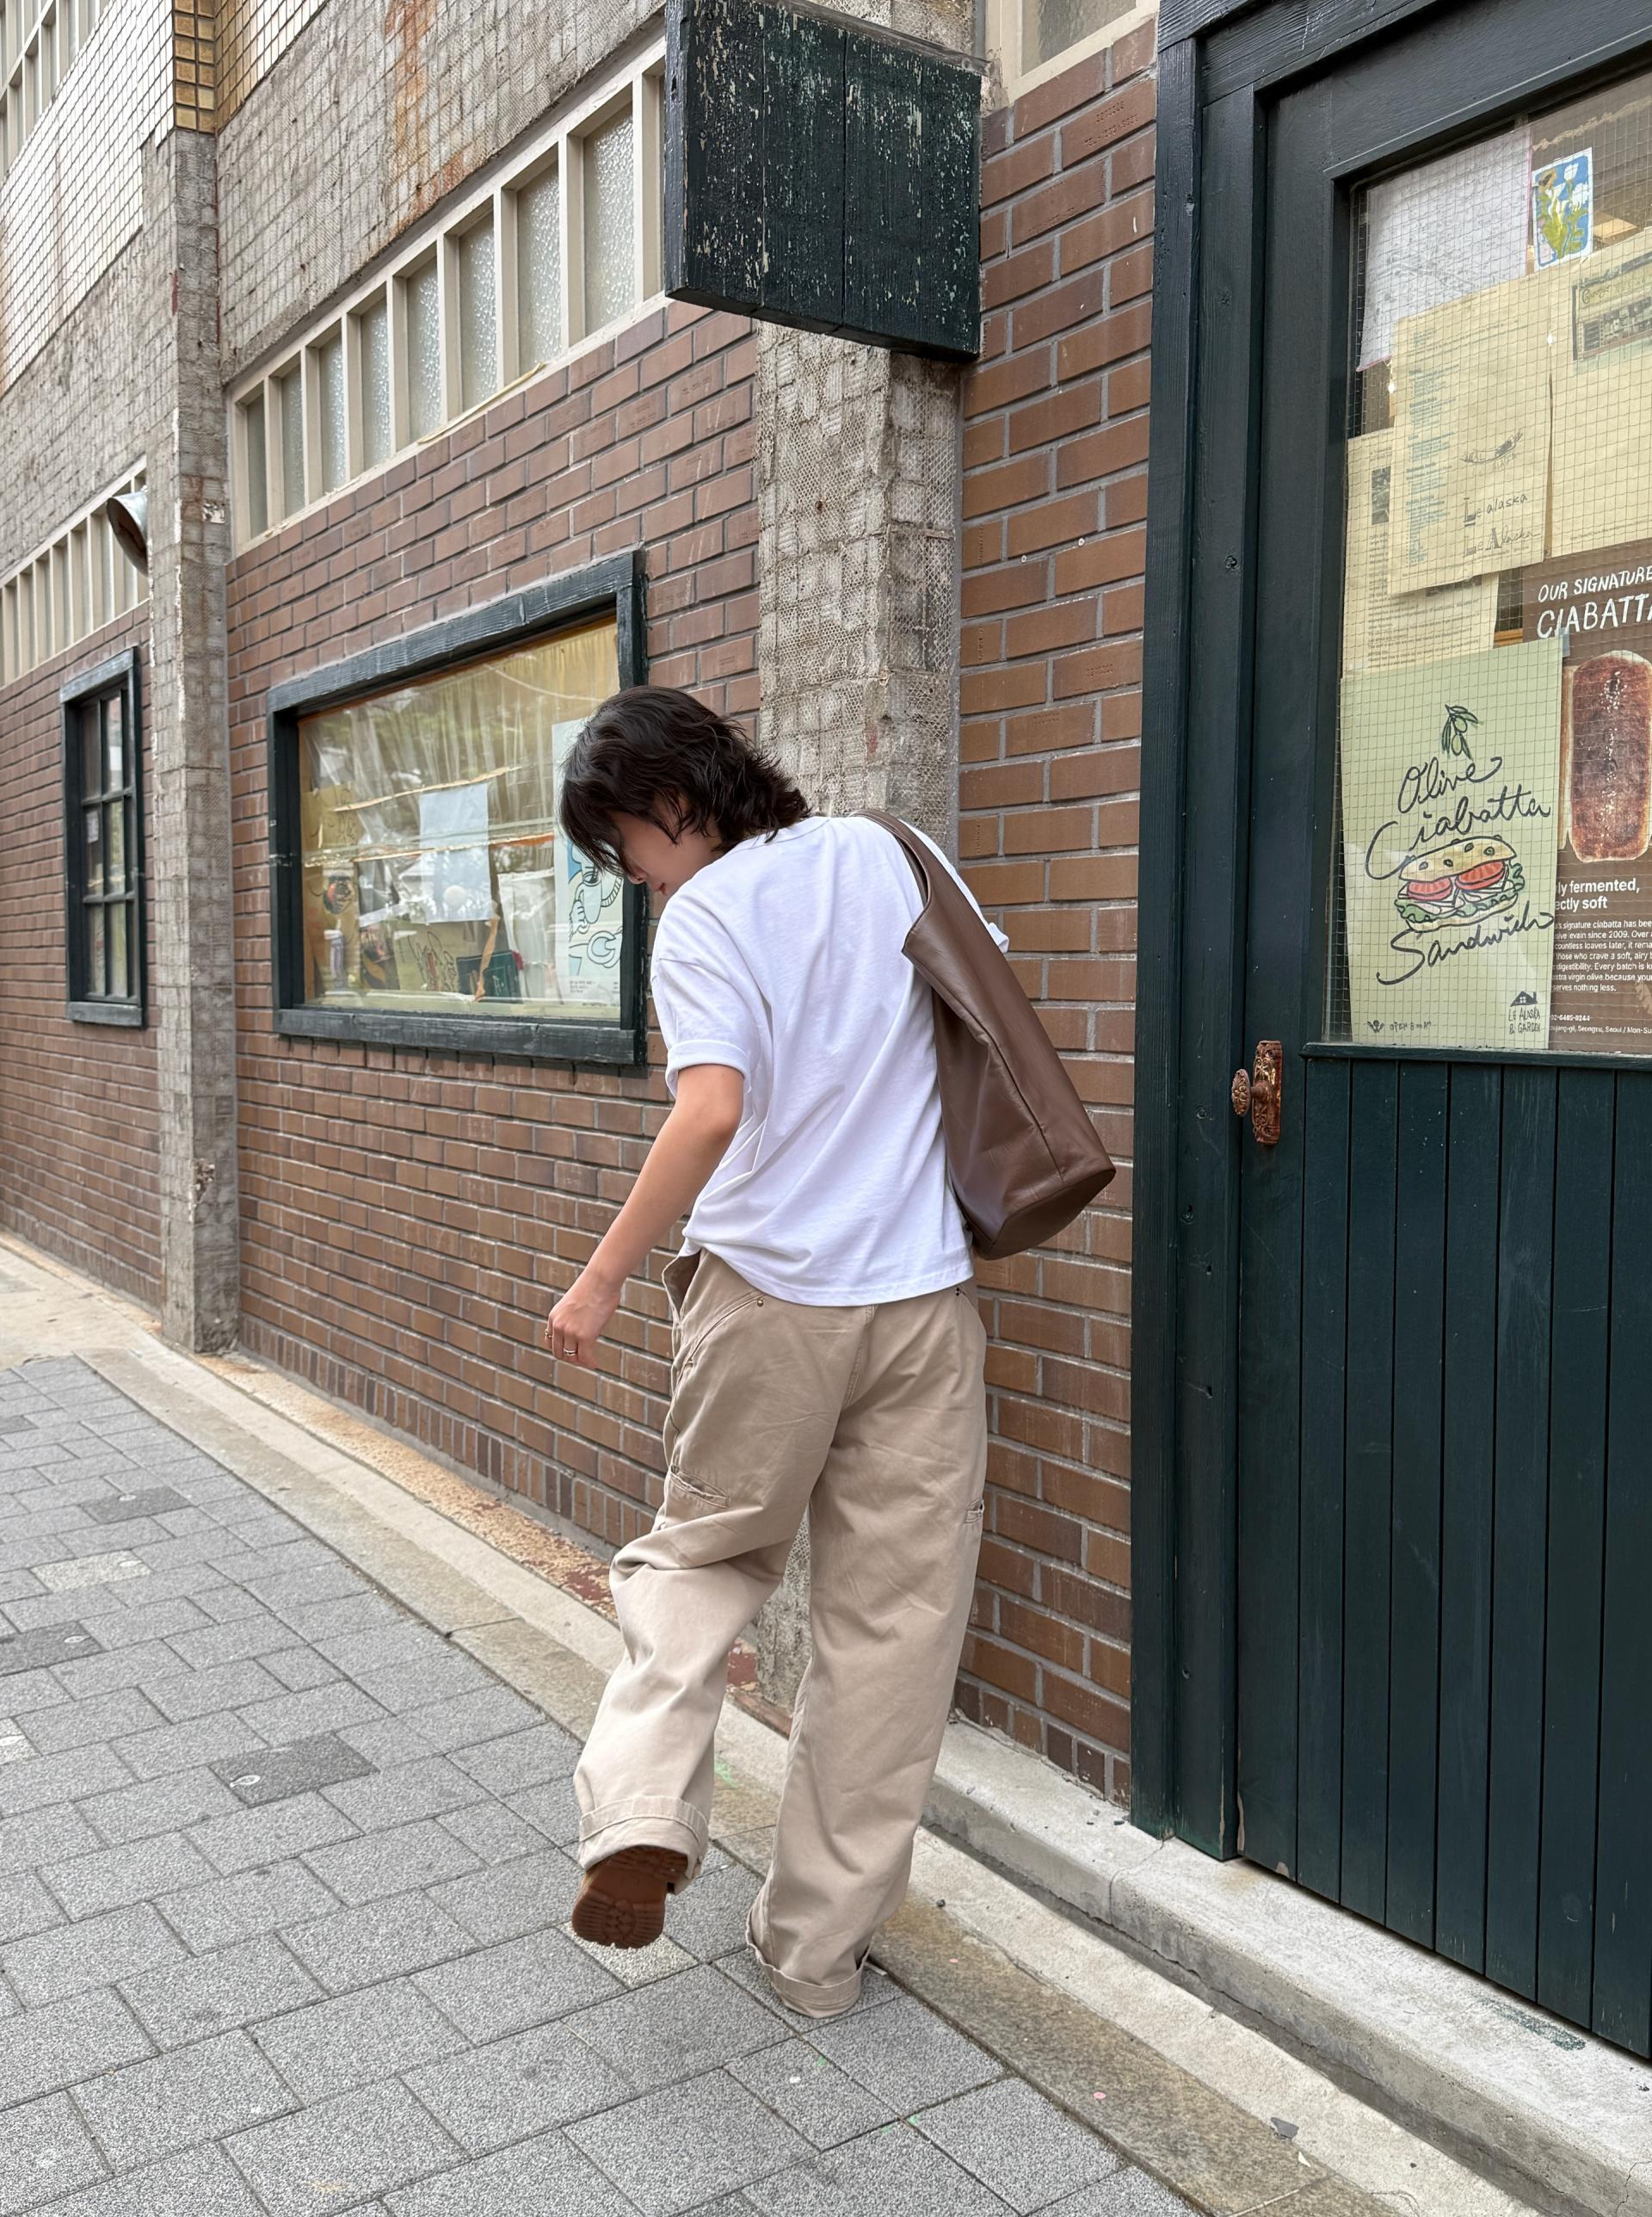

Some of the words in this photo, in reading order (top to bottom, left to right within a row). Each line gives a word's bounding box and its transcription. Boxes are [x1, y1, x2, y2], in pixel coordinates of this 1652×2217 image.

[1486, 493, 1528, 515] alaska
[1538, 581, 1569, 603] OUR
[1573, 565, 1652, 596] SIGNATURE
[1537, 593, 1652, 639] CIABATT
[1397, 756, 1503, 814] Olive
[1365, 783, 1551, 880] Ciabatta
[1569, 877, 1640, 894] fermented,
[1555, 897, 1581, 913] ectly
[1581, 895, 1608, 910] soft
[1563, 921, 1591, 931] signature
[1593, 919, 1622, 929] ciabatta
[1623, 919, 1637, 929] has
[1638, 918, 1652, 929] bee
[1587, 930, 1606, 939] since
[1608, 930, 1630, 939] 2009.
[1631, 929, 1649, 938] Over
[1376, 900, 1555, 985] Sandwich
[1608, 941, 1626, 950] later,
[1628, 940, 1633, 948] it
[1634, 951, 1649, 961] airy
[1594, 962, 1615, 973] Every
[1616, 962, 1637, 971] batch
[1568, 973, 1586, 983] virgin
[1587, 973, 1603, 981] olive
[1637, 974, 1652, 983] you
[1600, 983, 1617, 991] less.
[1627, 1026, 1652, 1034] Mon-Su
